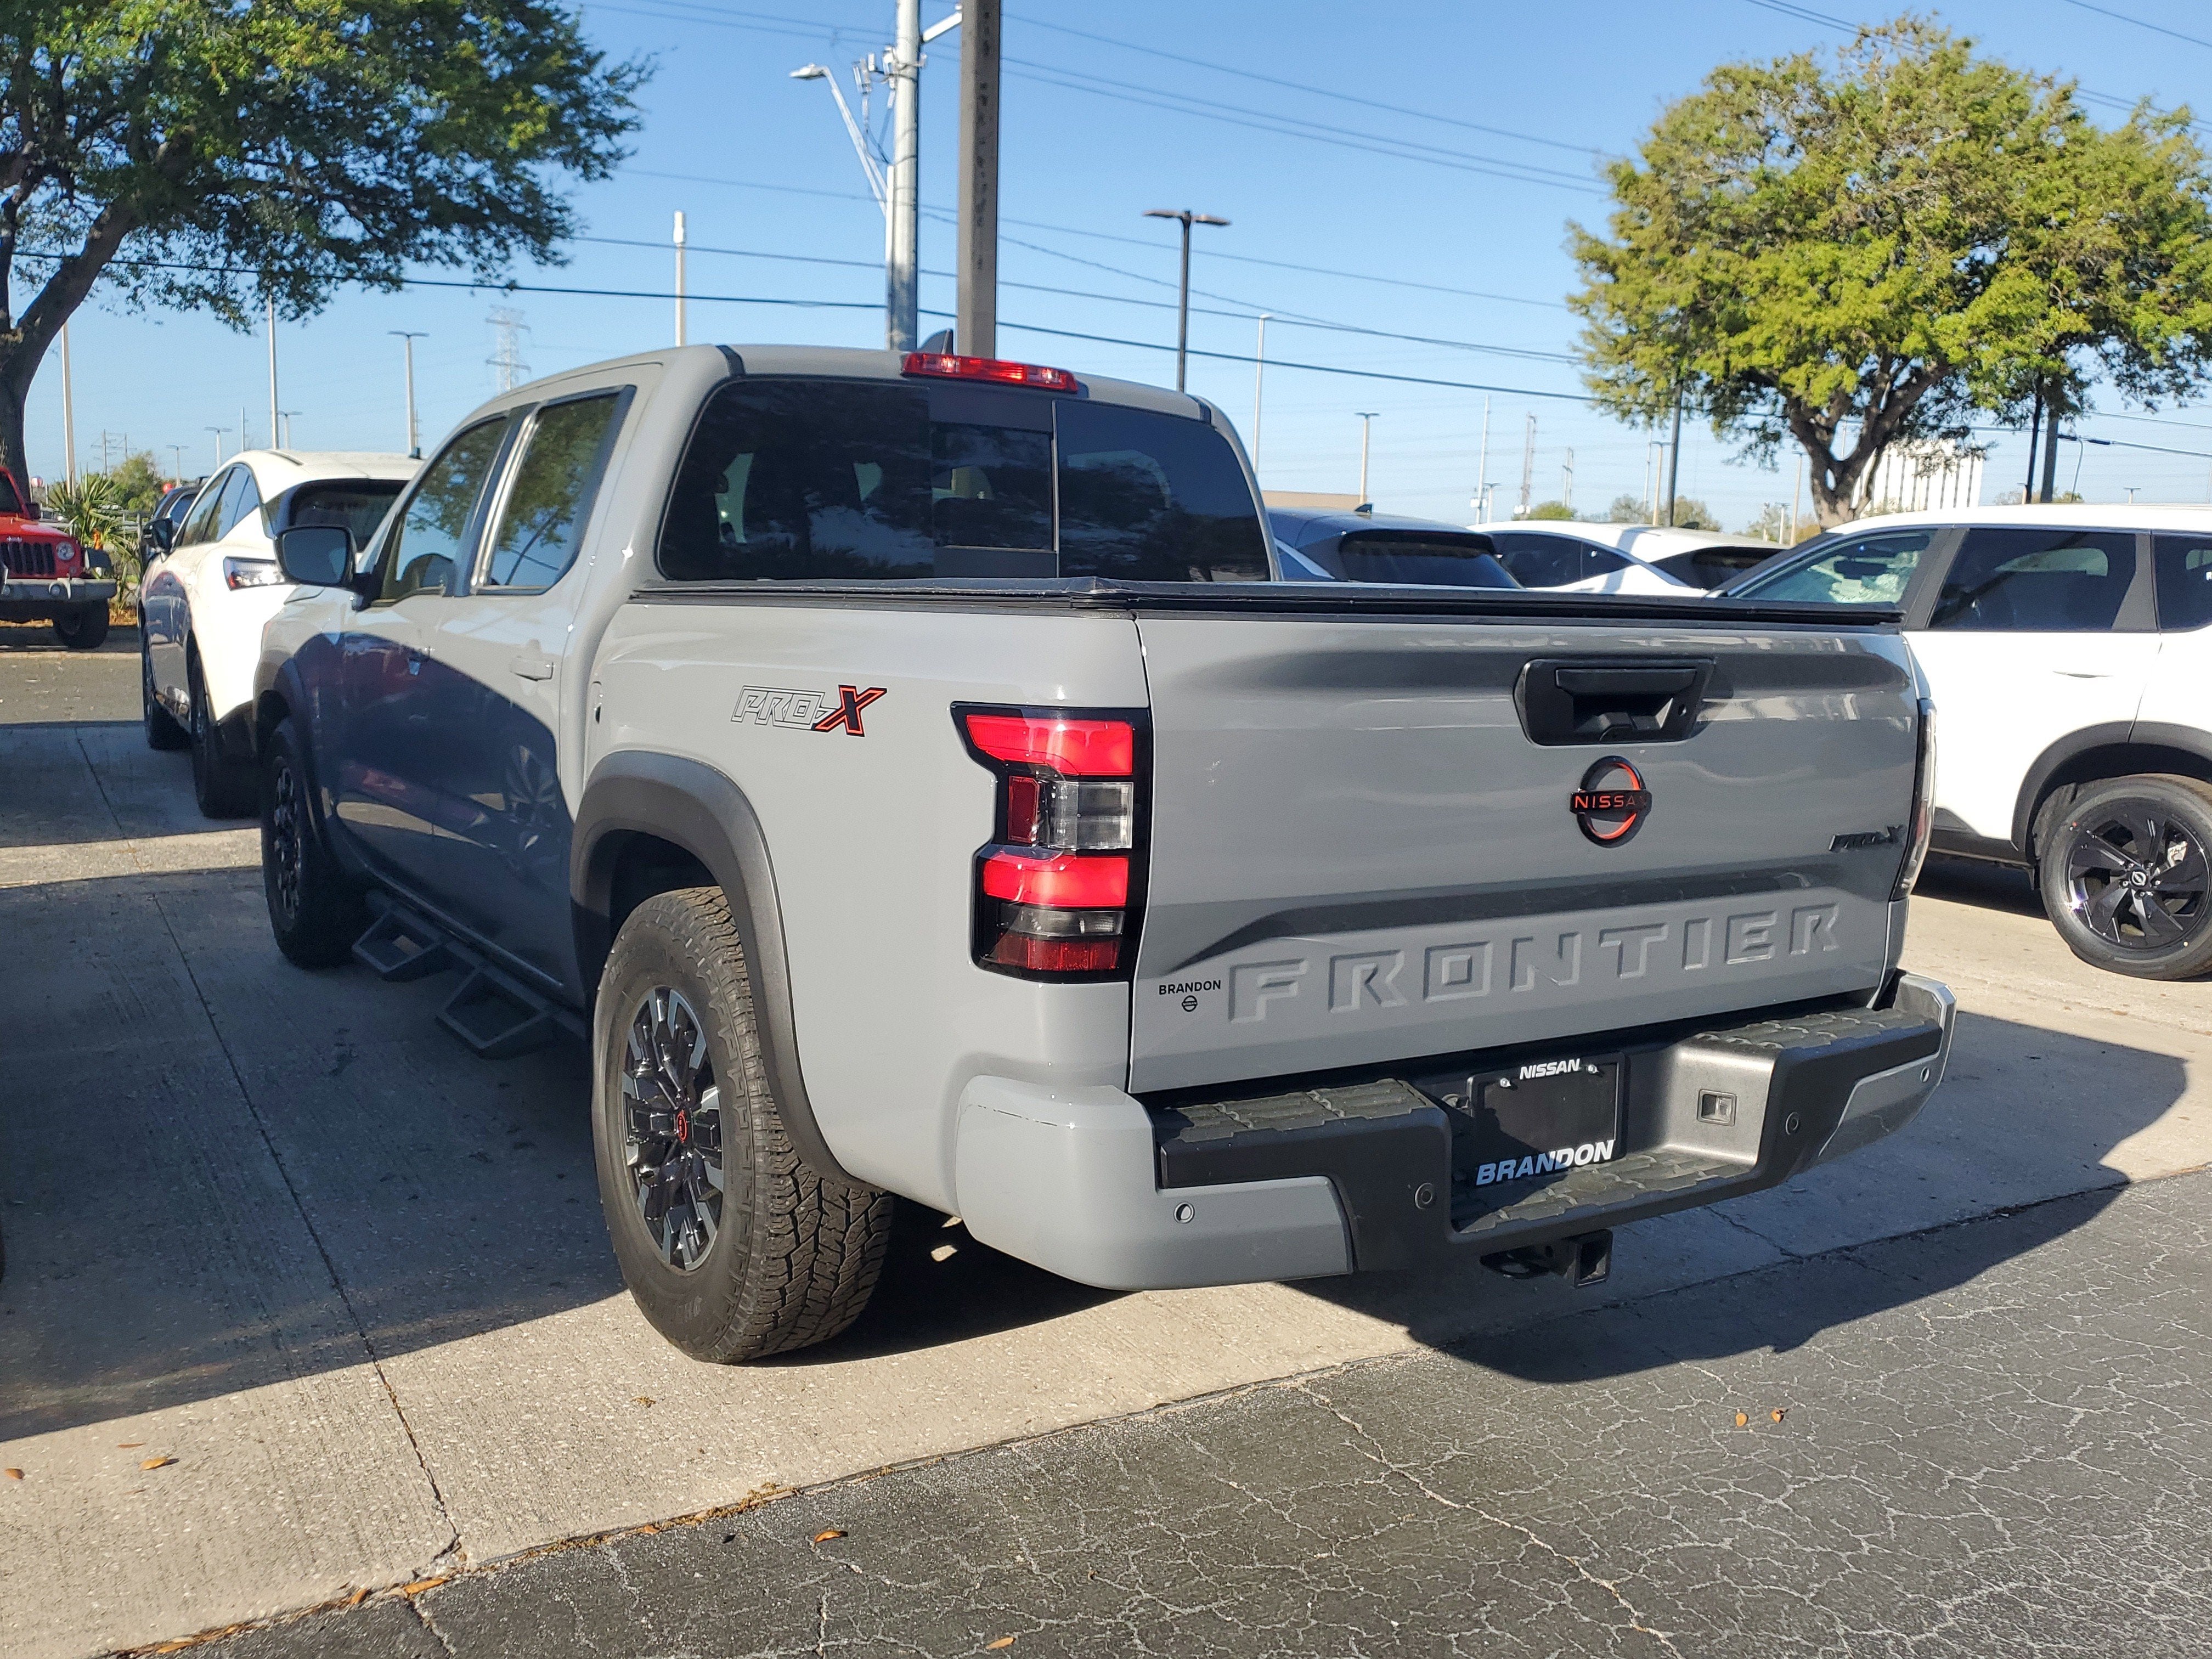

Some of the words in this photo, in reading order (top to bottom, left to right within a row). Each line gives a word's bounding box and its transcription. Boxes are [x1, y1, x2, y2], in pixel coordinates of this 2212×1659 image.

[1228, 903, 1839, 1022] FRONTIER
[1159, 979, 1221, 995] BRANDON
[1520, 1058, 1581, 1080] NISSAN
[1476, 1139, 1615, 1186] BRANDON
